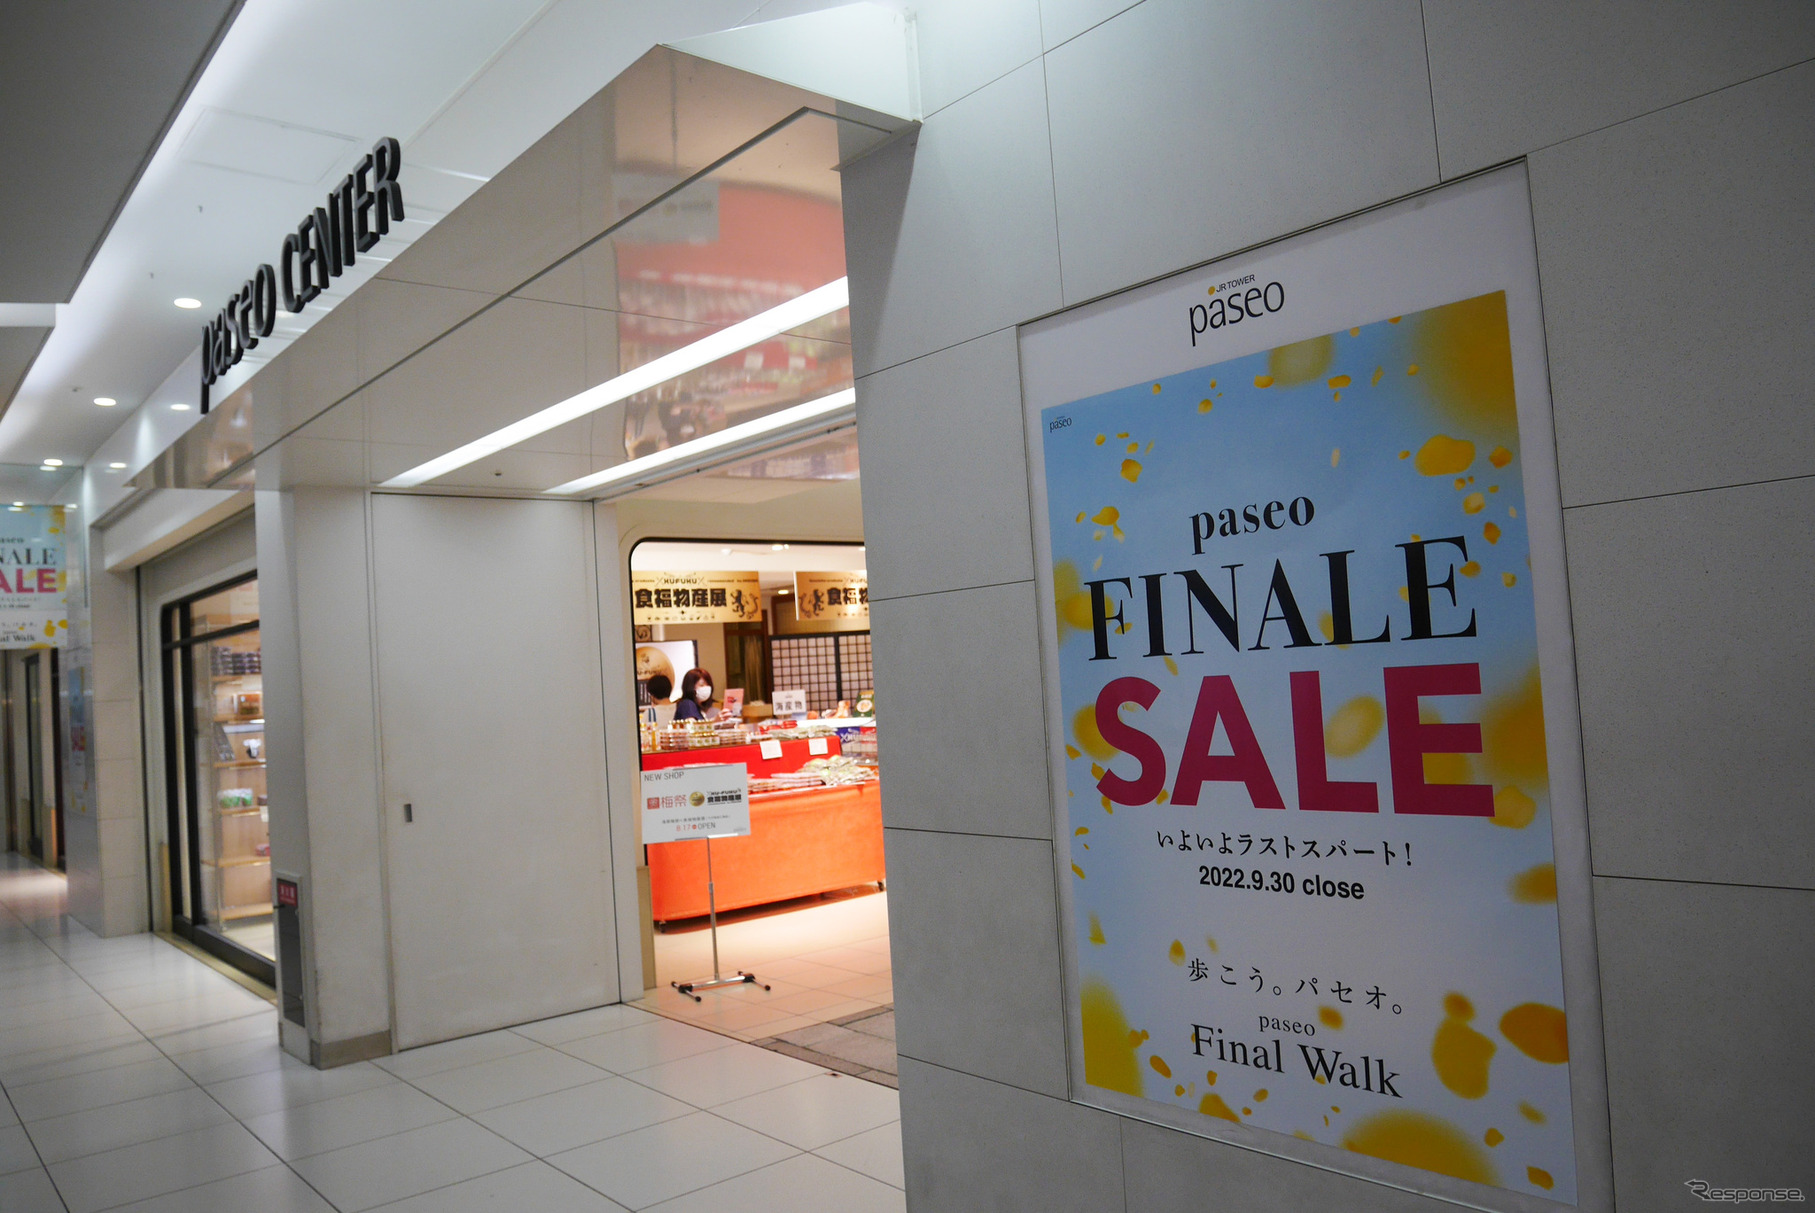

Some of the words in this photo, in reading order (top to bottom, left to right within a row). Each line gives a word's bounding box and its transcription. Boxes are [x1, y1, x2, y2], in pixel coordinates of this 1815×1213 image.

[200, 263, 277, 415] paseo
[281, 136, 405, 314] CENTER
[1216, 283, 1227, 293] JR
[1228, 274, 1256, 289] TOWER
[1189, 281, 1285, 347] paseo
[1049, 417, 1072, 433] paseo
[1188, 496, 1315, 556] paseo
[1083, 535, 1477, 661] FINALE
[1095, 662, 1496, 818] SALE
[644, 773, 661, 781] NEW
[664, 771, 685, 780] SHOP
[697, 822, 716, 830] OPEN
[1199, 865, 1295, 894] 2022.9.30
[1302, 874, 1365, 900] close
[1187, 957, 1403, 1015] 歩こう。パセオ。
[1258, 1015, 1316, 1037] paseo
[1191, 1023, 1286, 1074] Final
[1297, 1043, 1403, 1099] Walk
